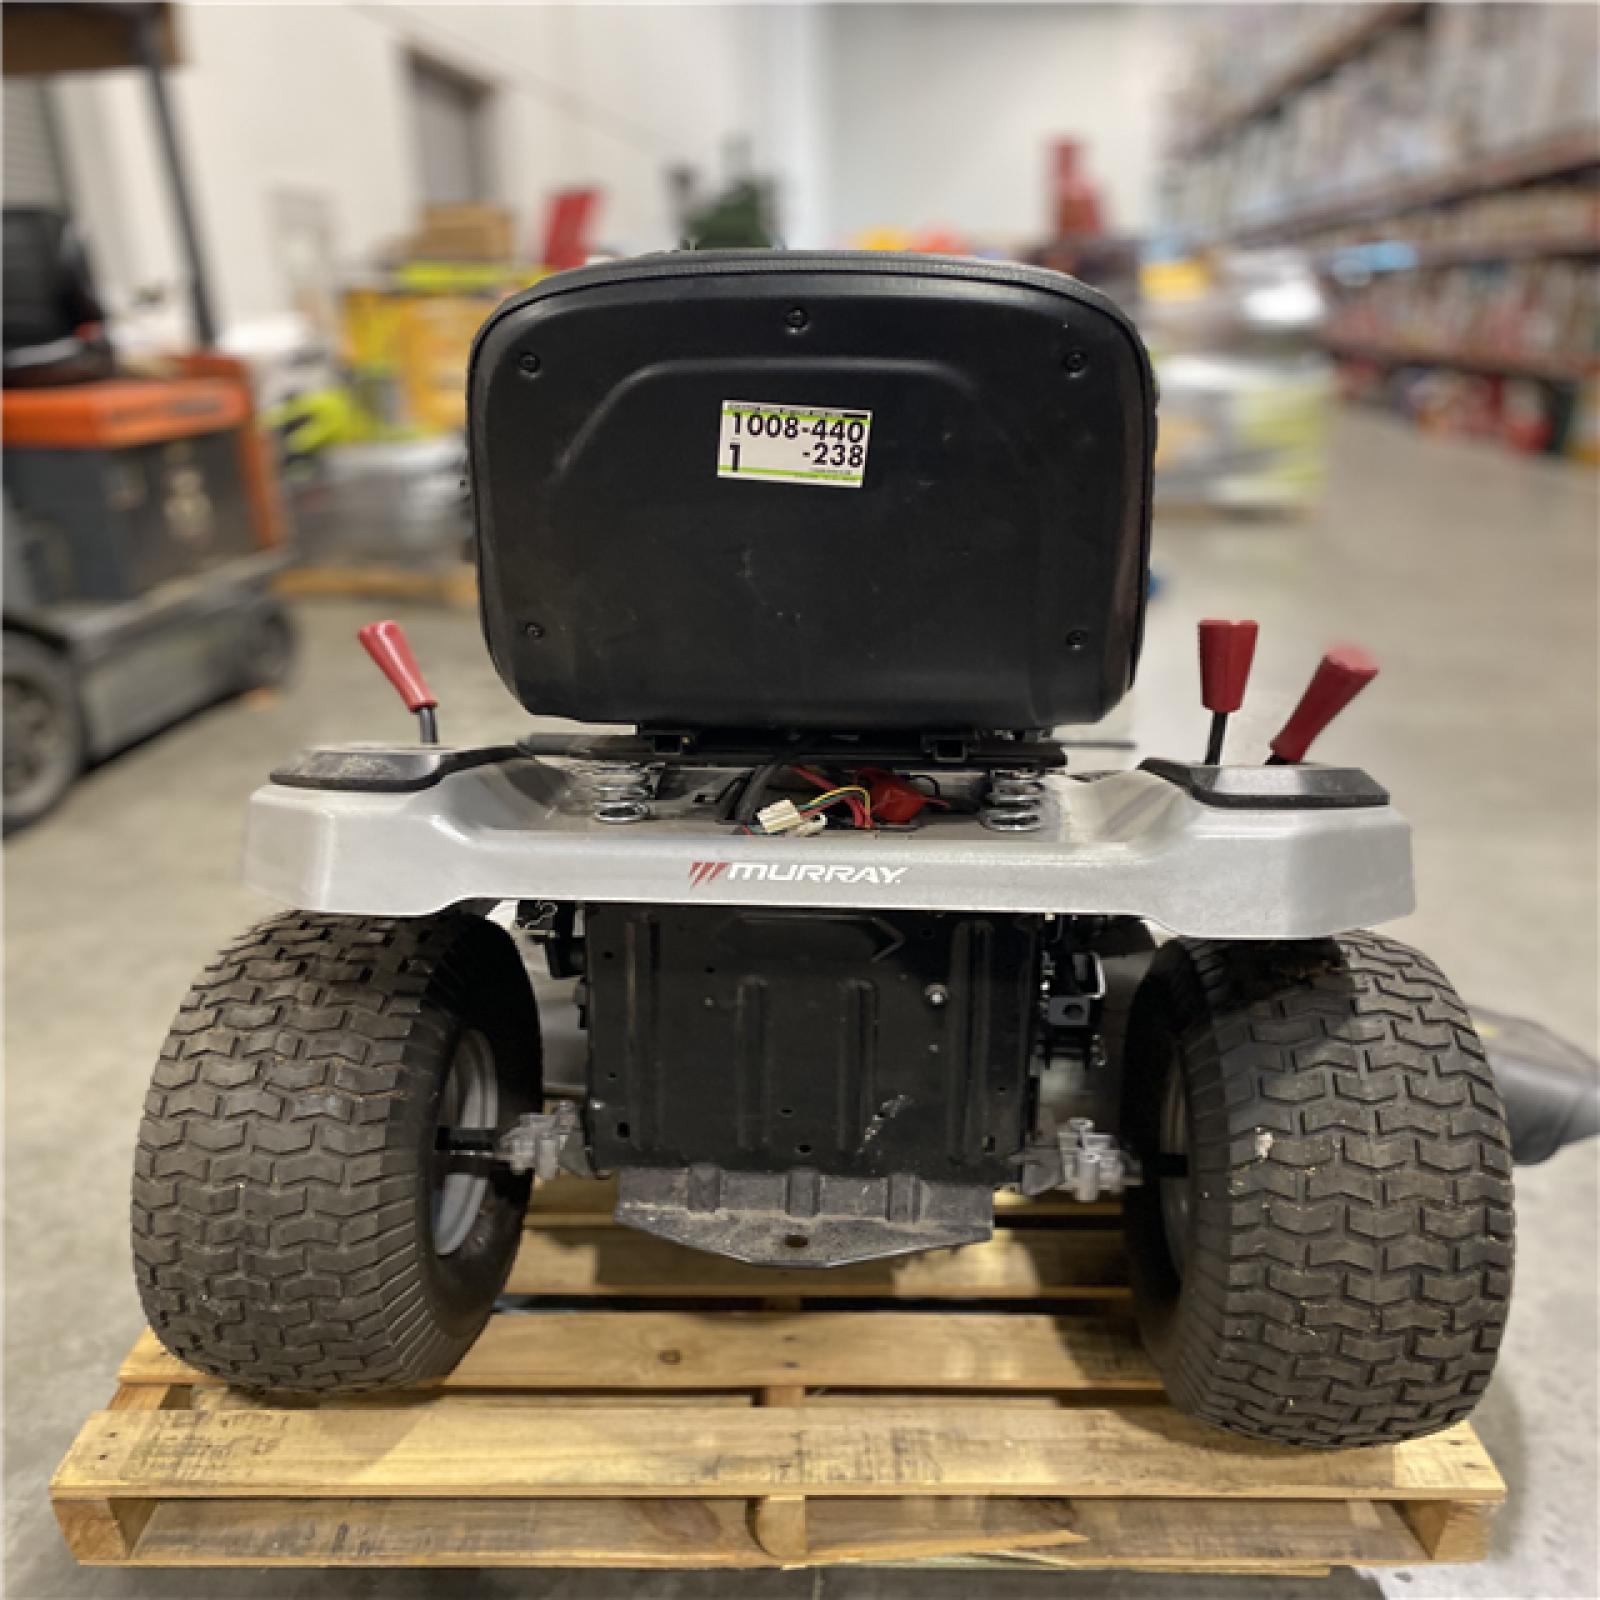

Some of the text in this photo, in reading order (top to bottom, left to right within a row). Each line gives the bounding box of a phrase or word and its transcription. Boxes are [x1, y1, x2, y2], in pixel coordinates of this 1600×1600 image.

[733, 412, 865, 442] 1008-440
[729, 443, 741, 472] 1
[803, 442, 864, 467] -238
[728, 864, 907, 883] MURRAY
